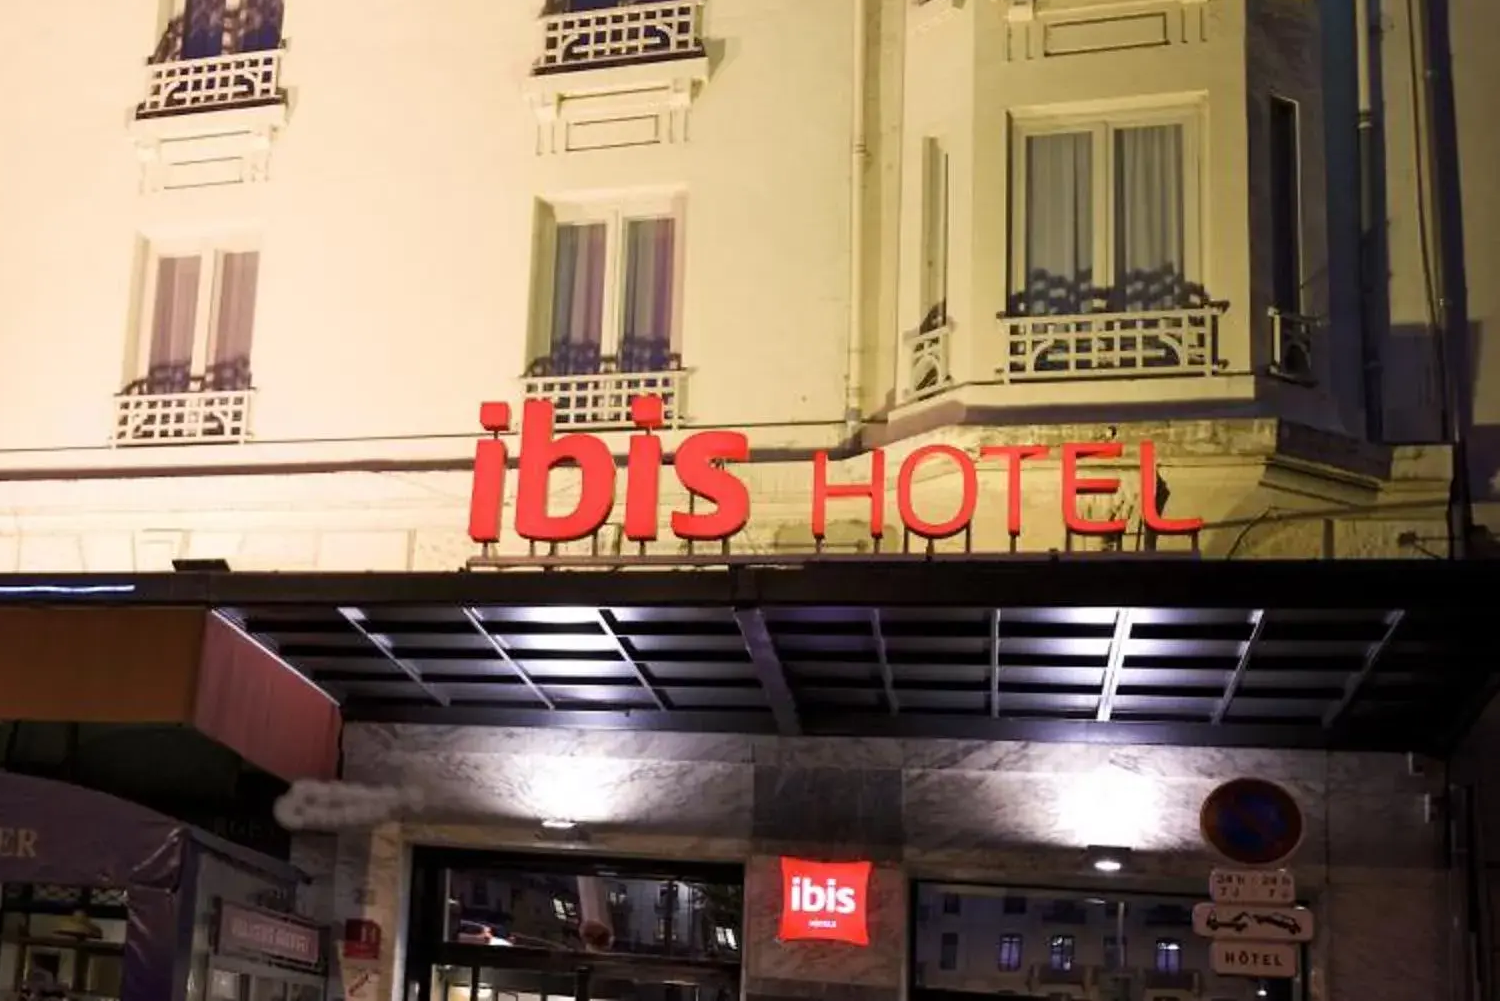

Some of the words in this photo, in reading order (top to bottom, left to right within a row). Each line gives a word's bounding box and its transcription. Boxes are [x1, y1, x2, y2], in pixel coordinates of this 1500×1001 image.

[468, 394, 752, 543] ibis
[810, 439, 1206, 540] HOTEL
[791, 875, 857, 915] ibis
[1224, 950, 1284, 967] HÔTEL
